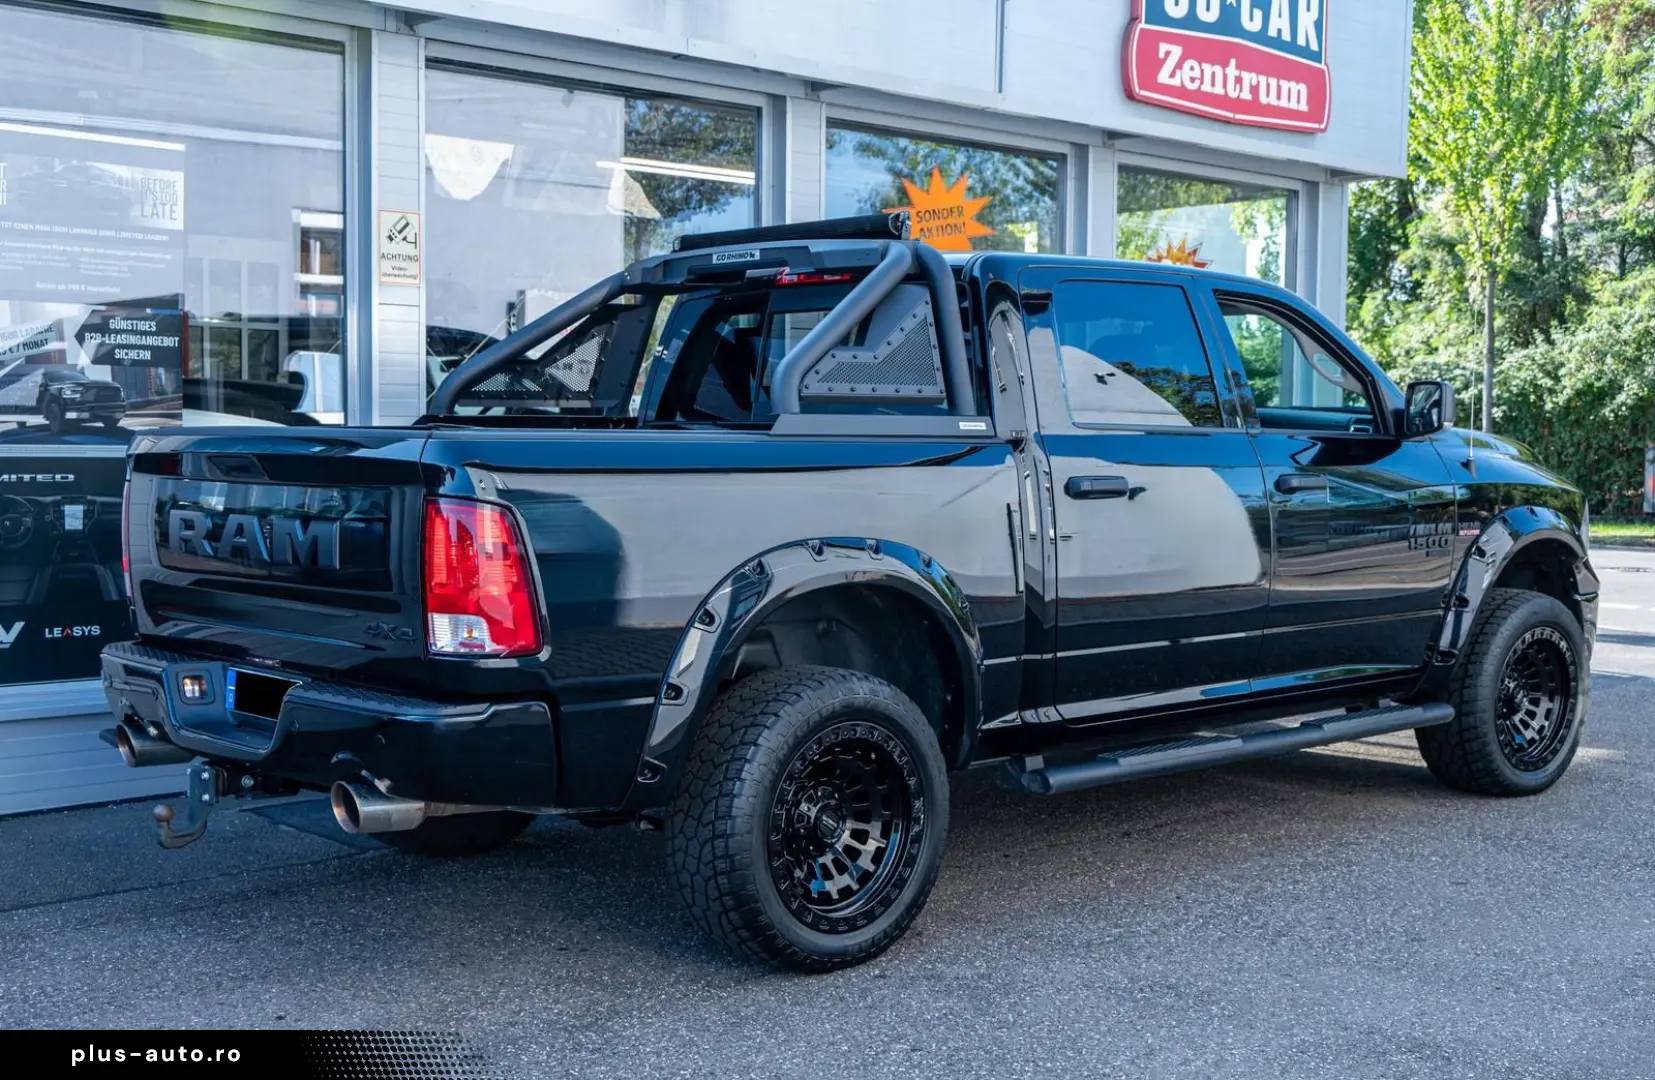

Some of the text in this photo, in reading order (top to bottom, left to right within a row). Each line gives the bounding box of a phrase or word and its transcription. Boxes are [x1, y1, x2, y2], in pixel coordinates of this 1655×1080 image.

[1157, 42, 1309, 112] Zentrum
[140, 177, 177, 191] BEFORE
[158, 191, 178, 206] TOO
[140, 200, 177, 220] LATE
[916, 205, 965, 224] SONDER
[919, 221, 966, 239] AKTION!
[381, 252, 419, 263] ACHTUNG
[109, 317, 157, 332] GÜNSTIGES
[22, 338, 48, 352] MONAT
[84, 332, 180, 348] B2B-LEASINGANGEBOT
[114, 348, 151, 361] SICHERN
[168, 509, 340, 571] RAM
[1408, 535, 1450, 550] 1500
[45, 625, 101, 638] LEASYS
